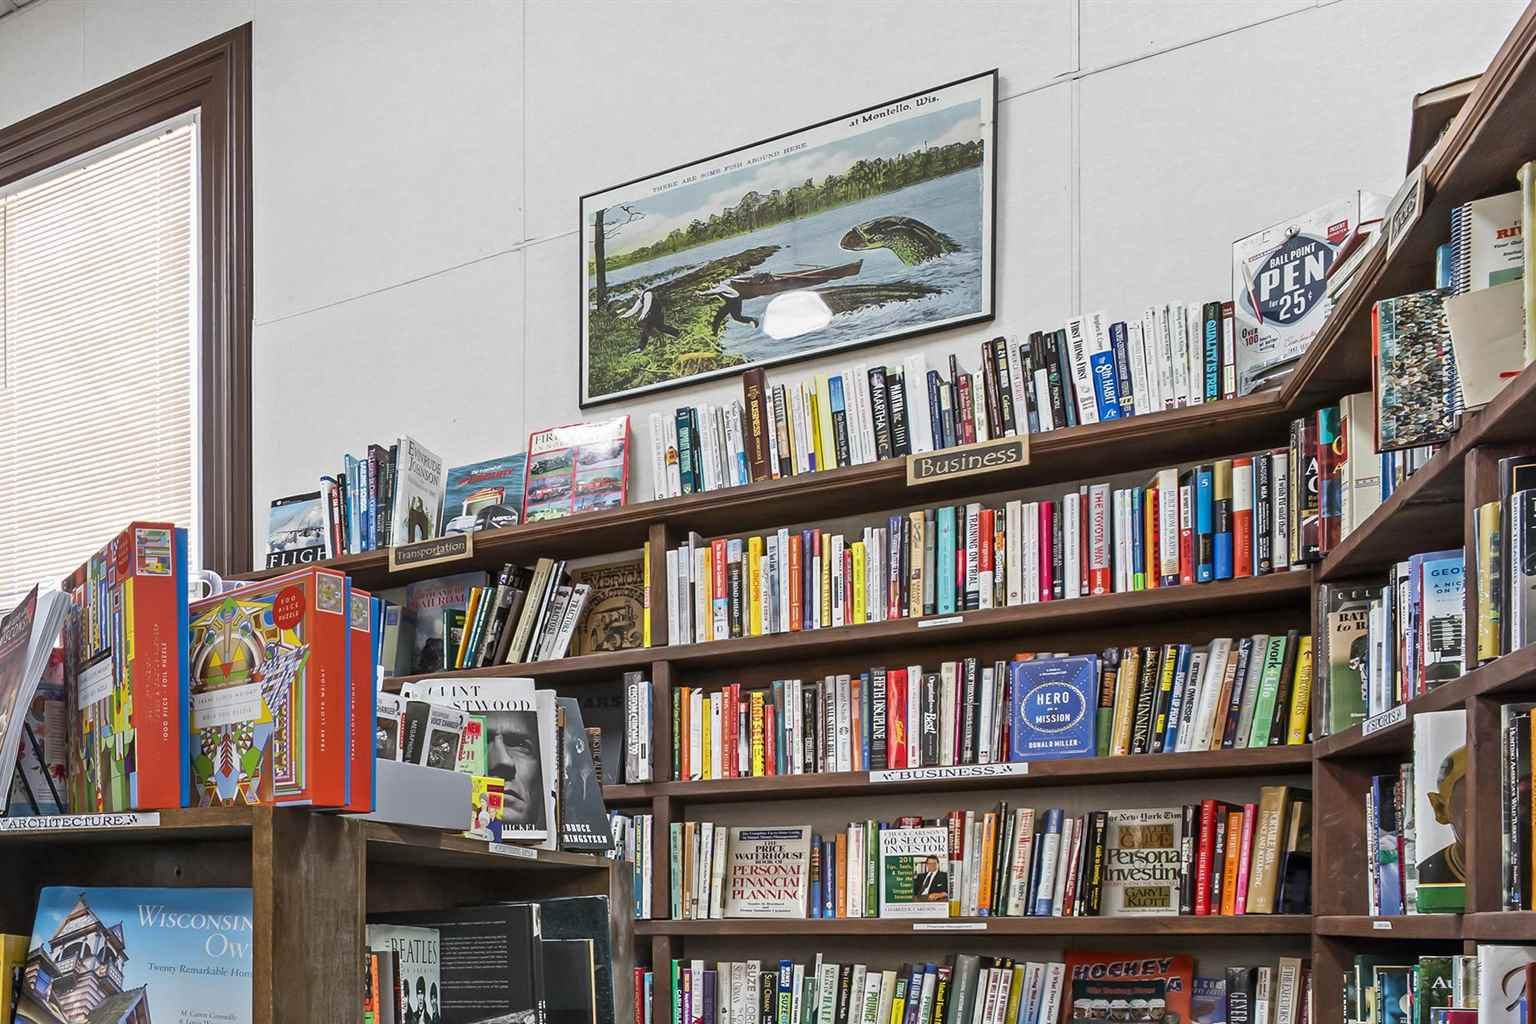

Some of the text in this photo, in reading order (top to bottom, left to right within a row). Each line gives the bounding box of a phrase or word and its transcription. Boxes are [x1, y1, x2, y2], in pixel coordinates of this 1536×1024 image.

[849, 118, 860, 128] at
[1269, 241, 1317, 269] BALL POINT
[1260, 250, 1325, 303] PEN
[1206, 319, 1217, 359] QUALITY
[920, 448, 1018, 477] Business
[1094, 490, 1104, 567] THE TOYOTA WAY
[396, 541, 466, 562] Transportation
[966, 512, 979, 587] TRAINING TRIAL
[1267, 639, 1281, 669] Work
[427, 684, 481, 698] CLINT
[1035, 691, 1071, 706] HERO
[454, 699, 532, 712] STWOOD
[873, 697, 886, 741] DISCIPLINE
[1035, 713, 1072, 724] MISSION
[1028, 738, 1078, 749] DONALD MILLER
[7, 814, 125, 828] ARCHITECTURE
[1119, 811, 1163, 823] New York
[565, 823, 591, 833] BRUCE
[564, 834, 608, 845] RINGSTEEN
[883, 835, 947, 846] 60 SECOND
[754, 844, 786, 854] PRICE
[884, 844, 947, 854] INVESTOR
[731, 876, 801, 889] FINANCIAL
[205, 933, 253, 960] OW
[391, 937, 440, 966] BEATLES
[149, 961, 229, 977] Twenty Remarkable
[1072, 958, 1174, 980] HOCKEY
[746, 963, 758, 993] SUZE
